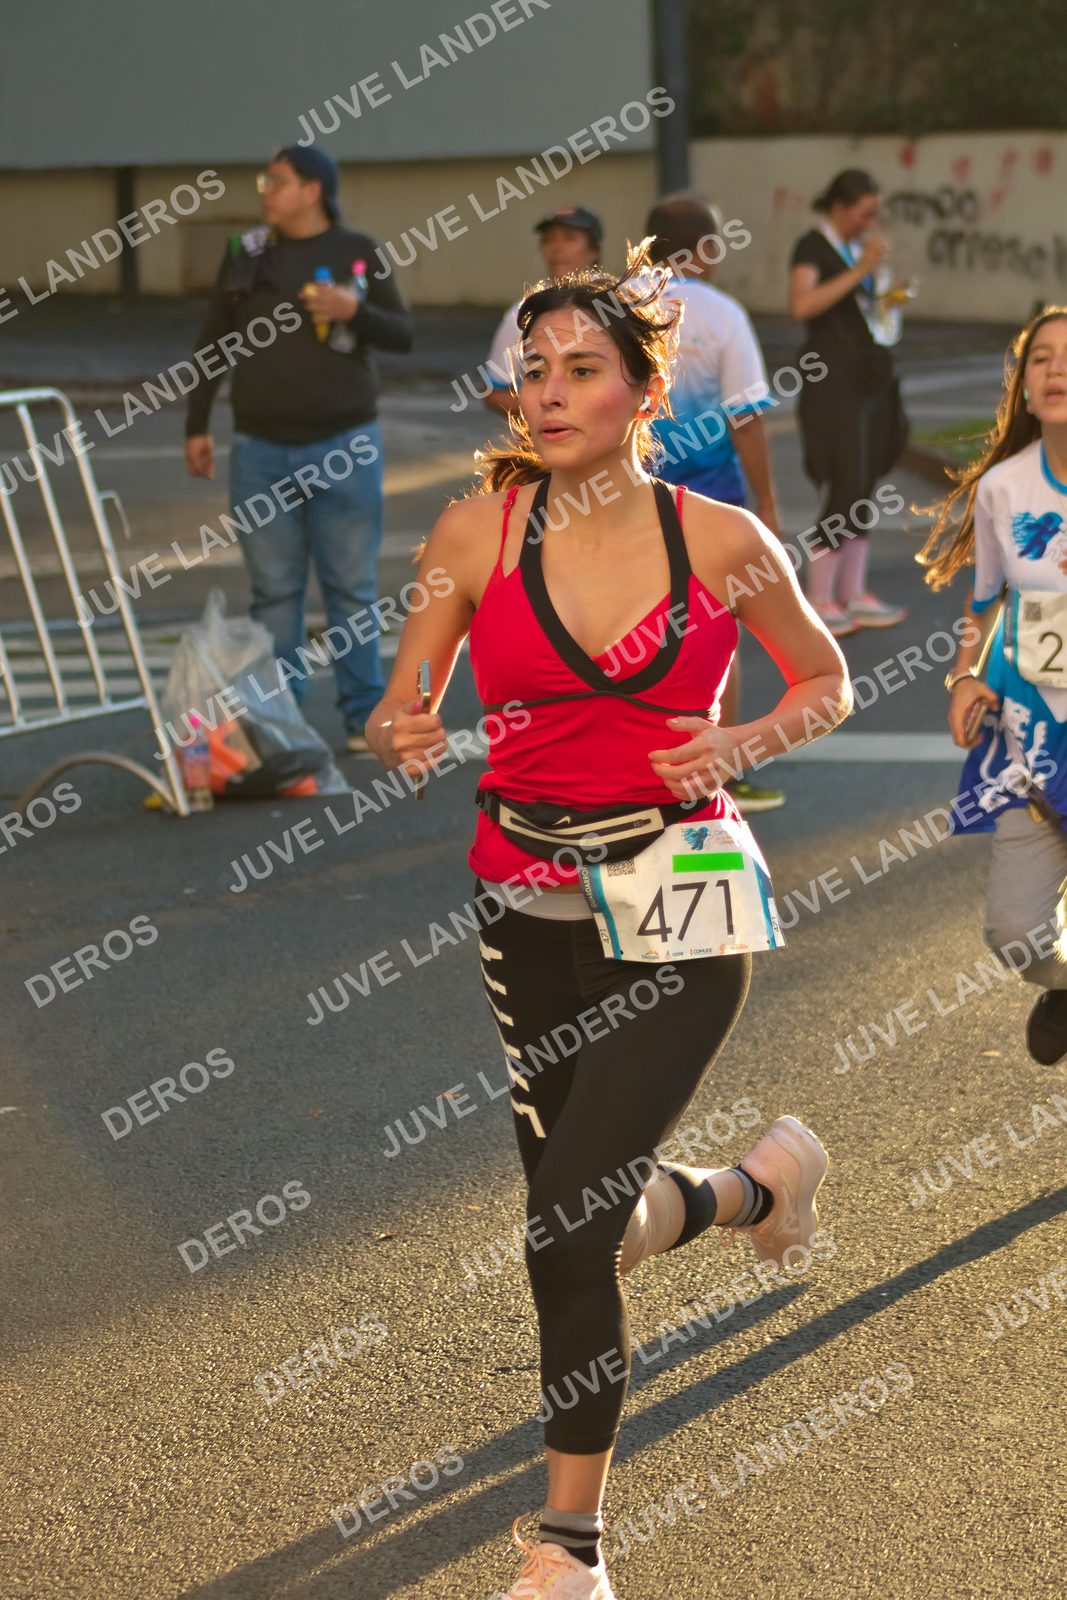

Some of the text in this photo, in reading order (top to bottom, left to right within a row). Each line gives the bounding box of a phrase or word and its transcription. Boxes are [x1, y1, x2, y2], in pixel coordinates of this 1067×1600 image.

[1038, 631, 1064, 673] 2
[636, 879, 734, 943] 471
[600, 928, 610, 944] 471
